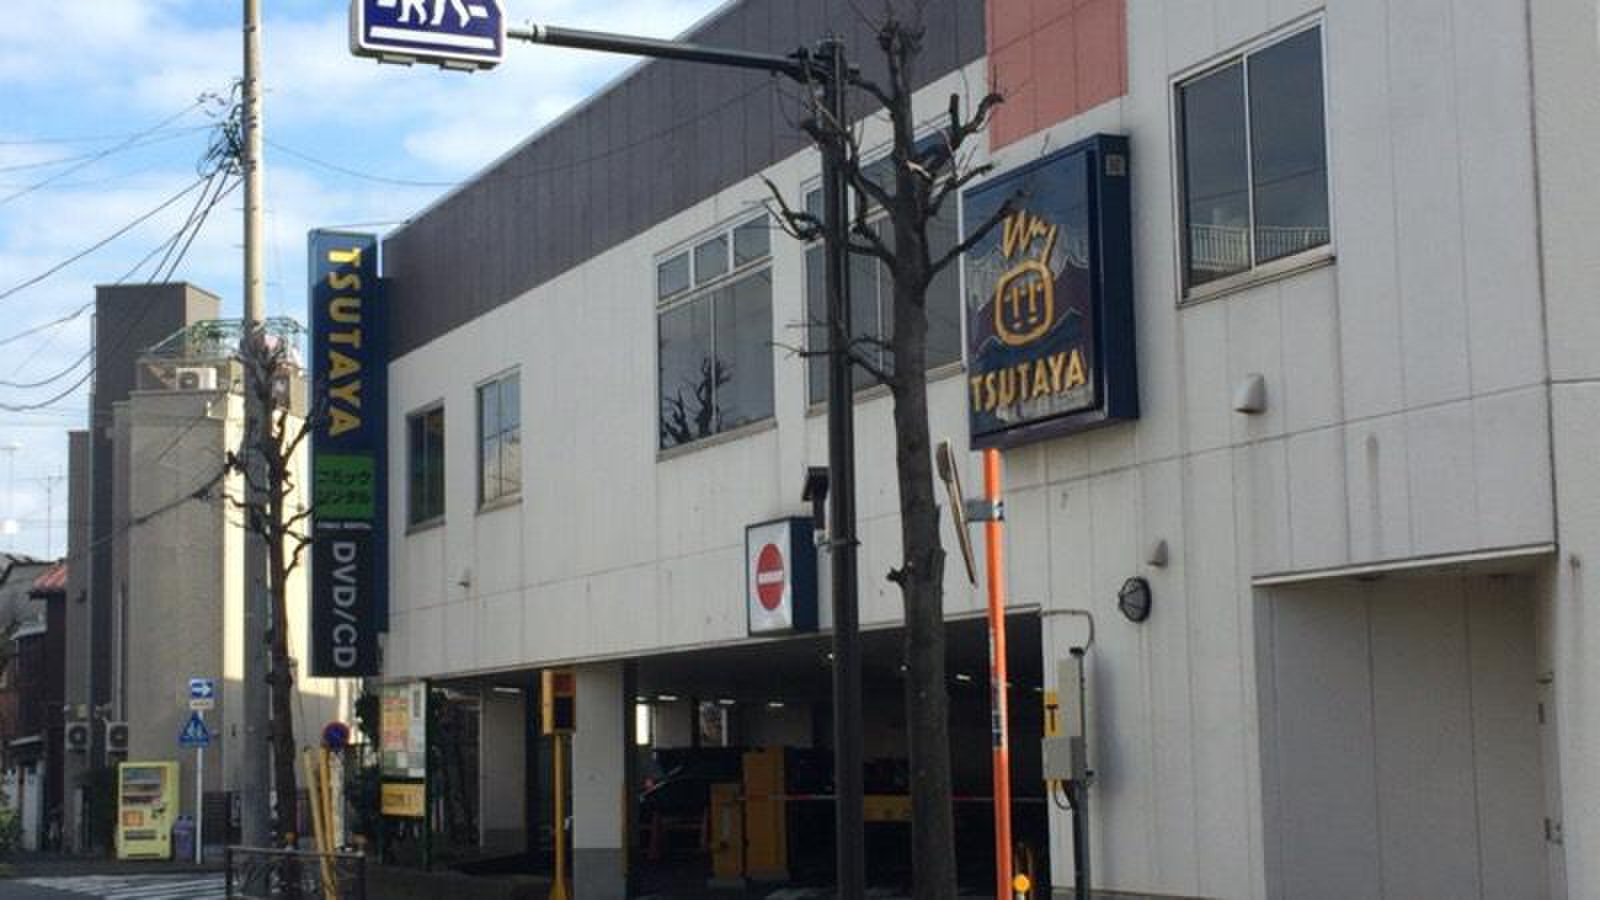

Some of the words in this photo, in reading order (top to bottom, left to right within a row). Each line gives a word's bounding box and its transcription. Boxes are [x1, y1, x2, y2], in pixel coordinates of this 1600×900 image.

[328, 247, 362, 437] TSUTAYA
[971, 347, 1086, 413] TSUTAYA
[332, 541, 358, 668] DVD/CD
